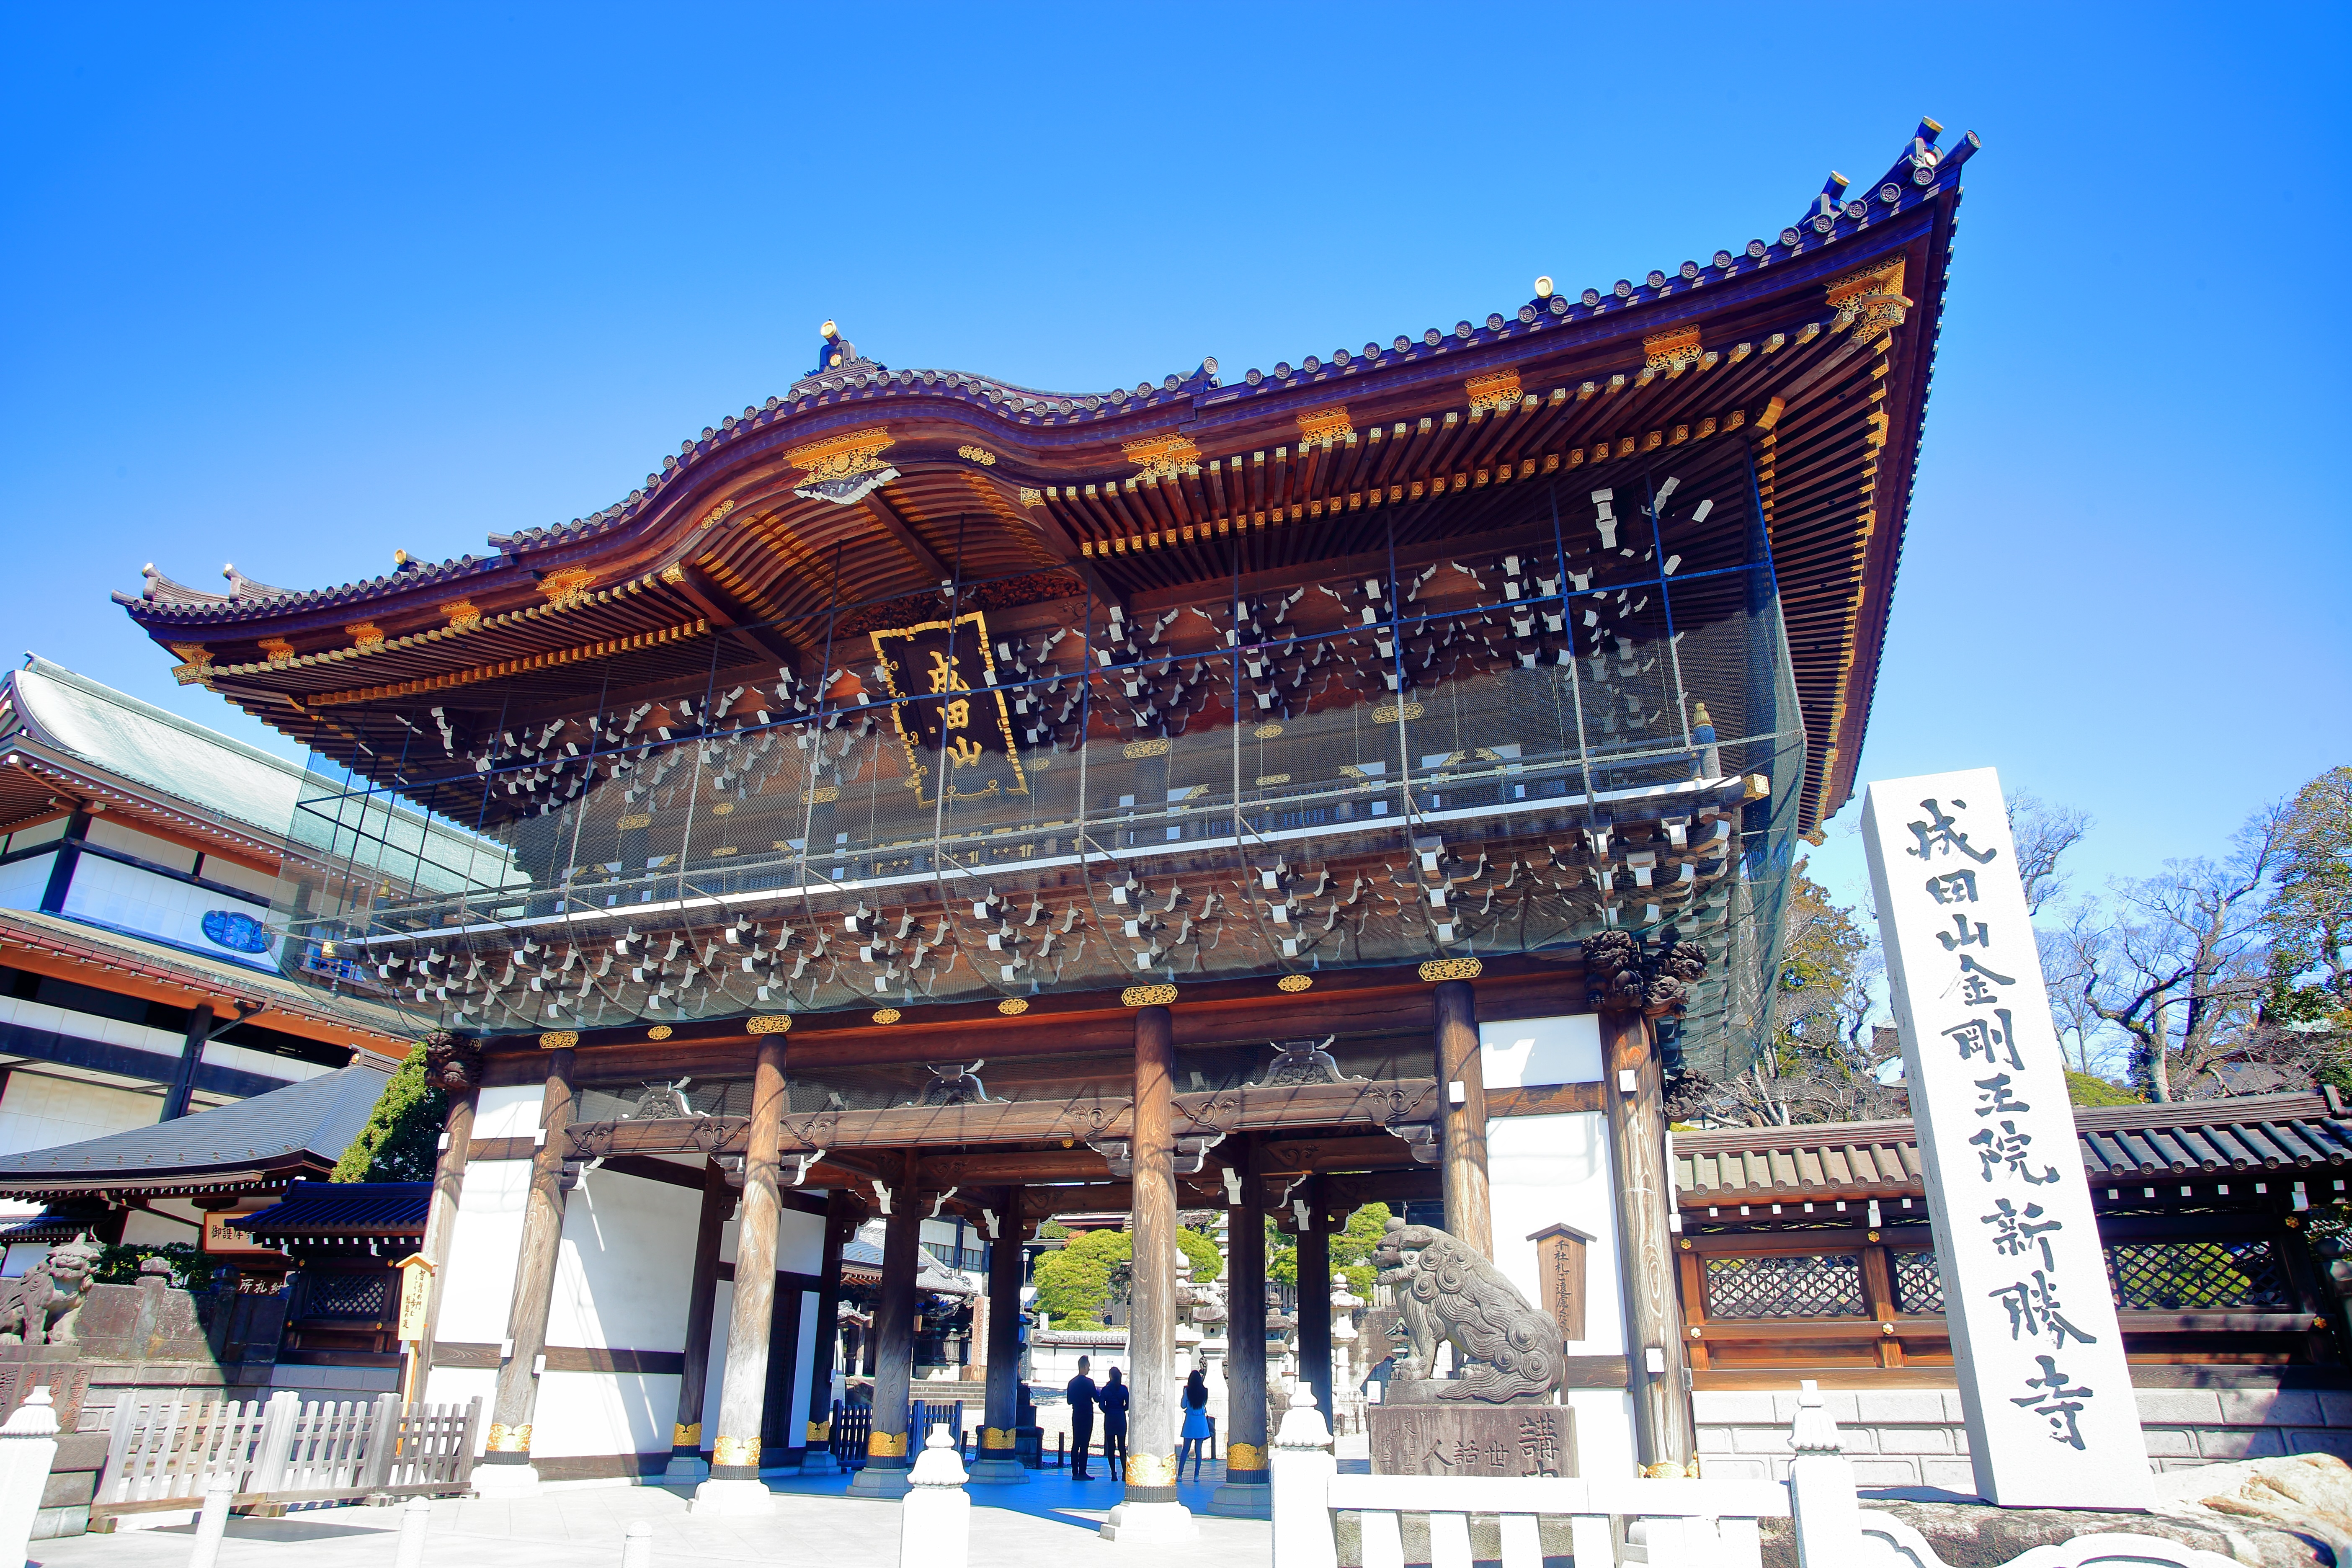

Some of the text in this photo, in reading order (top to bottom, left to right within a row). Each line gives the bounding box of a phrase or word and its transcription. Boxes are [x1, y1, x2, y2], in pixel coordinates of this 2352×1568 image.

[927, 651, 983, 769] 成田山
[1906, 797, 2097, 1450] 成田山金剛王院新勝寺
[1554, 1240, 1571, 1332] 千社札ご遠慮ください
